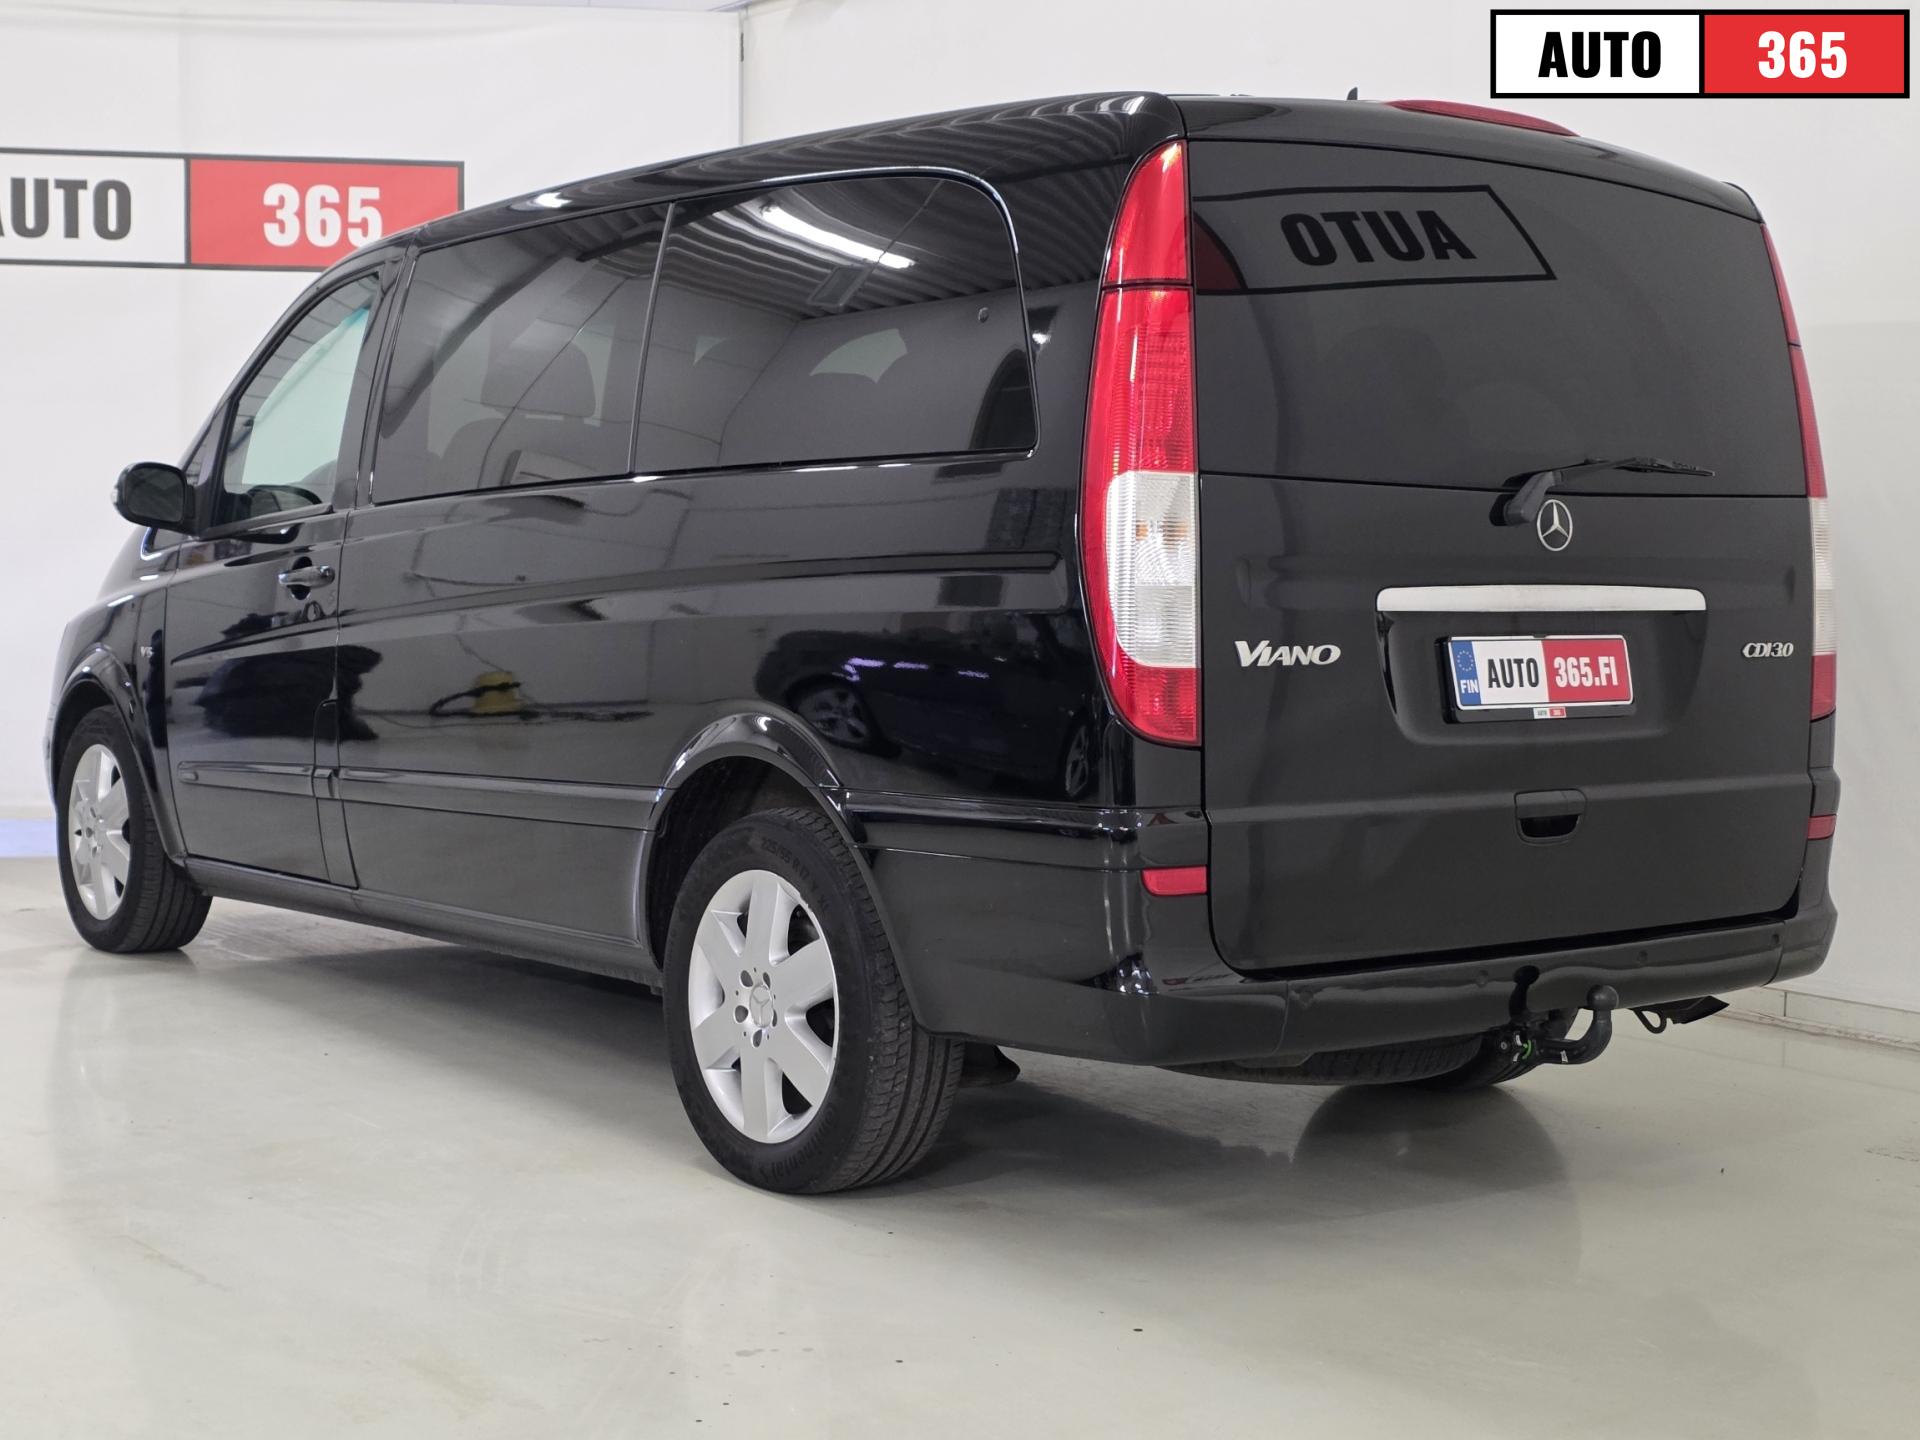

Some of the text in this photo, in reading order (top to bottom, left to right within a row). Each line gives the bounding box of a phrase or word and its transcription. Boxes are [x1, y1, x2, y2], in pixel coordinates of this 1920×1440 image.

[0, 176, 384, 249] UTO 365
[1234, 639, 1342, 668] VIANO
[1460, 679, 1479, 694] FIN
[1487, 656, 1619, 689] AUTO 365.FI
